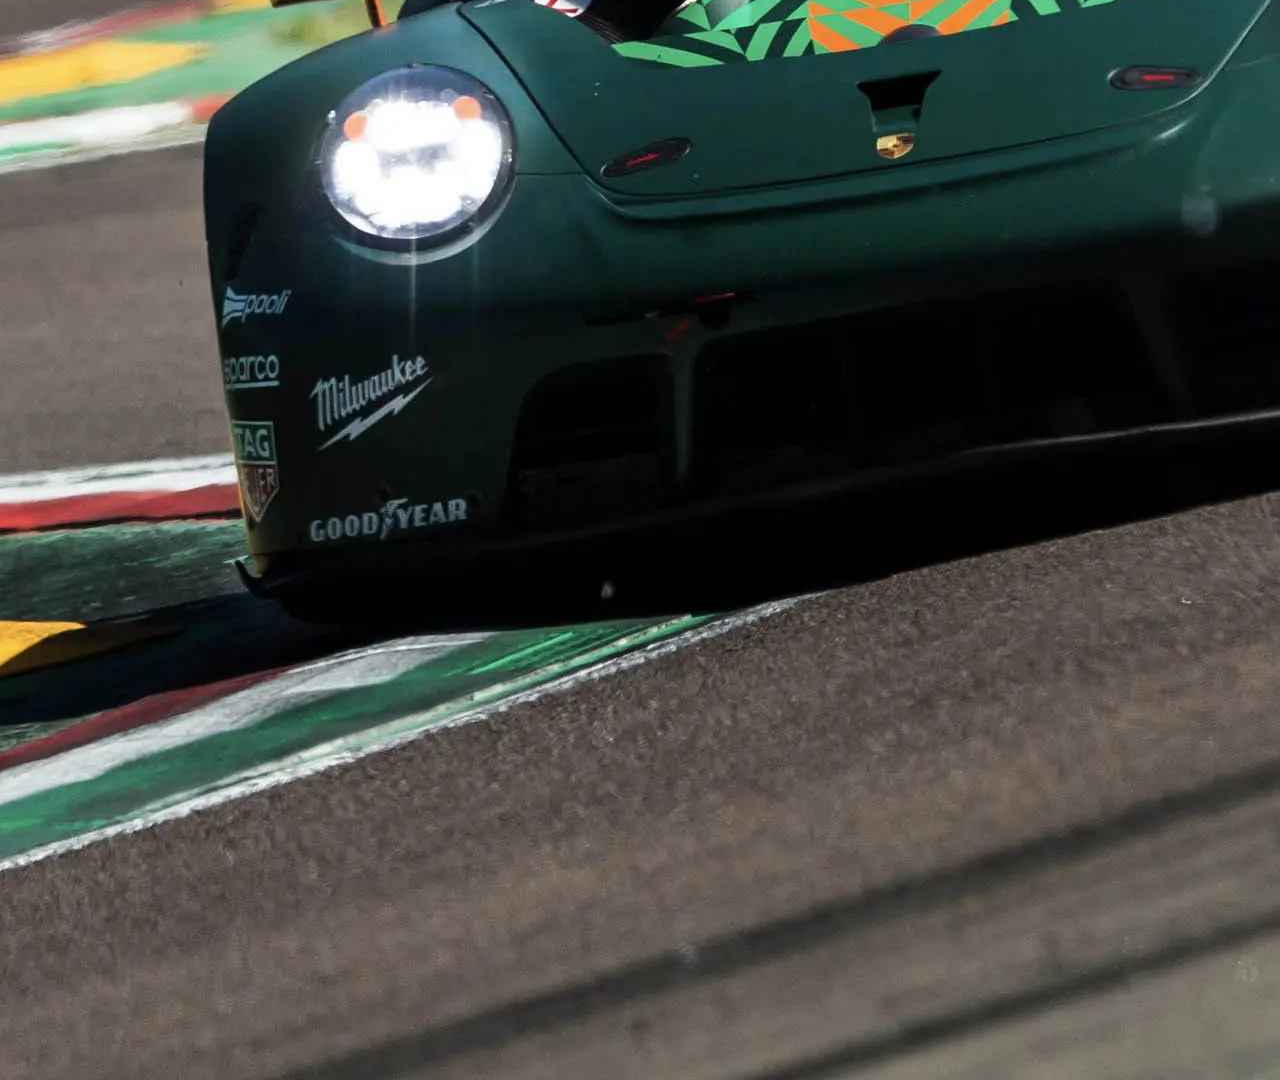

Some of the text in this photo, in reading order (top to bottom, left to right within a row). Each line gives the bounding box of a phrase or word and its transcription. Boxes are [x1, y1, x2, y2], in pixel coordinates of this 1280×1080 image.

[242, 289, 292, 323] paoli
[224, 355, 279, 390] sparco
[310, 354, 429, 431] Milwaukee
[235, 428, 270, 457] TAG
